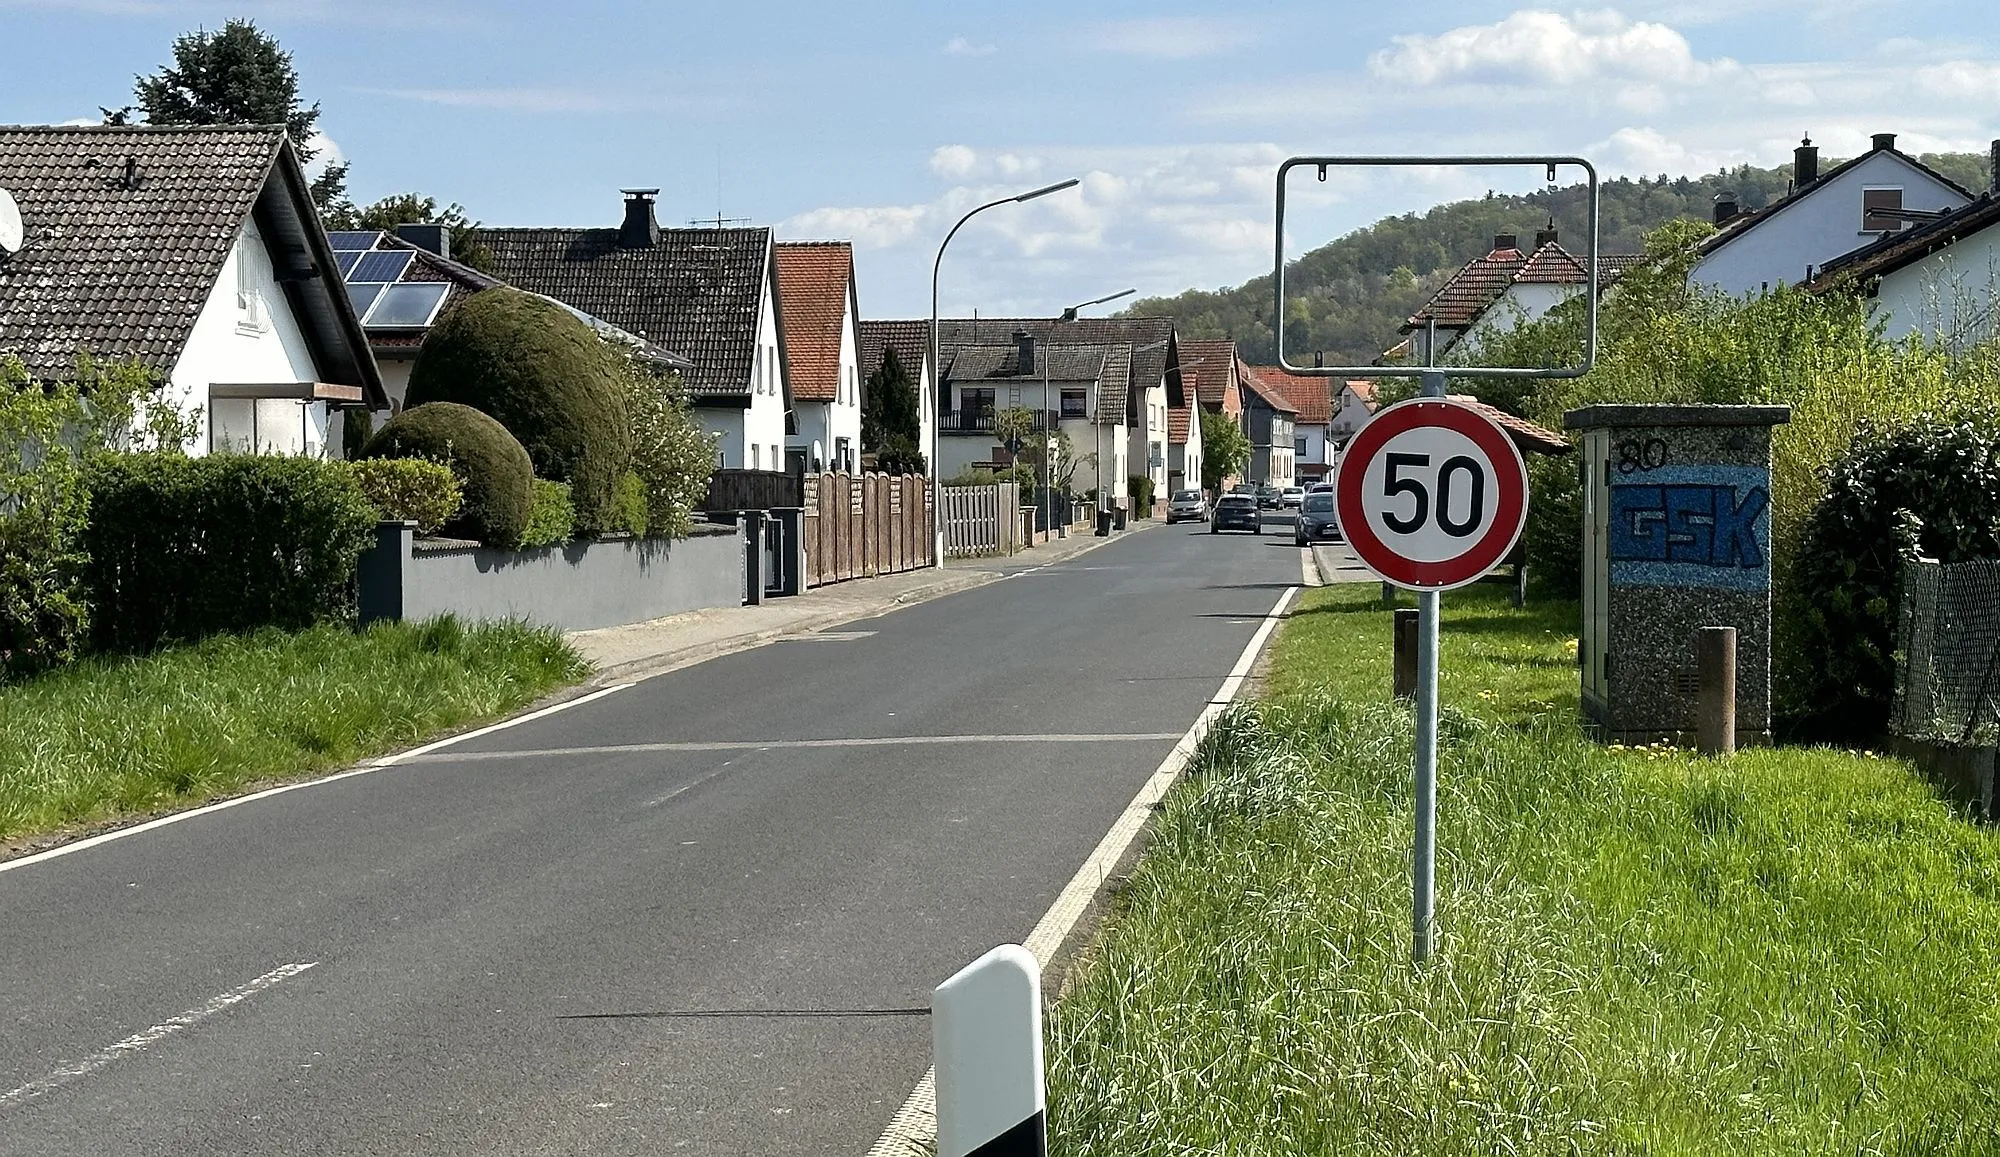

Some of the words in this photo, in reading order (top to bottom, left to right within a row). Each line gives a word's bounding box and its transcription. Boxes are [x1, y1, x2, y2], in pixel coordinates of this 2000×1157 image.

[1382, 452, 1484, 537] 50
[1618, 438, 1667, 474] 80
[1611, 483, 1770, 568] GSK
